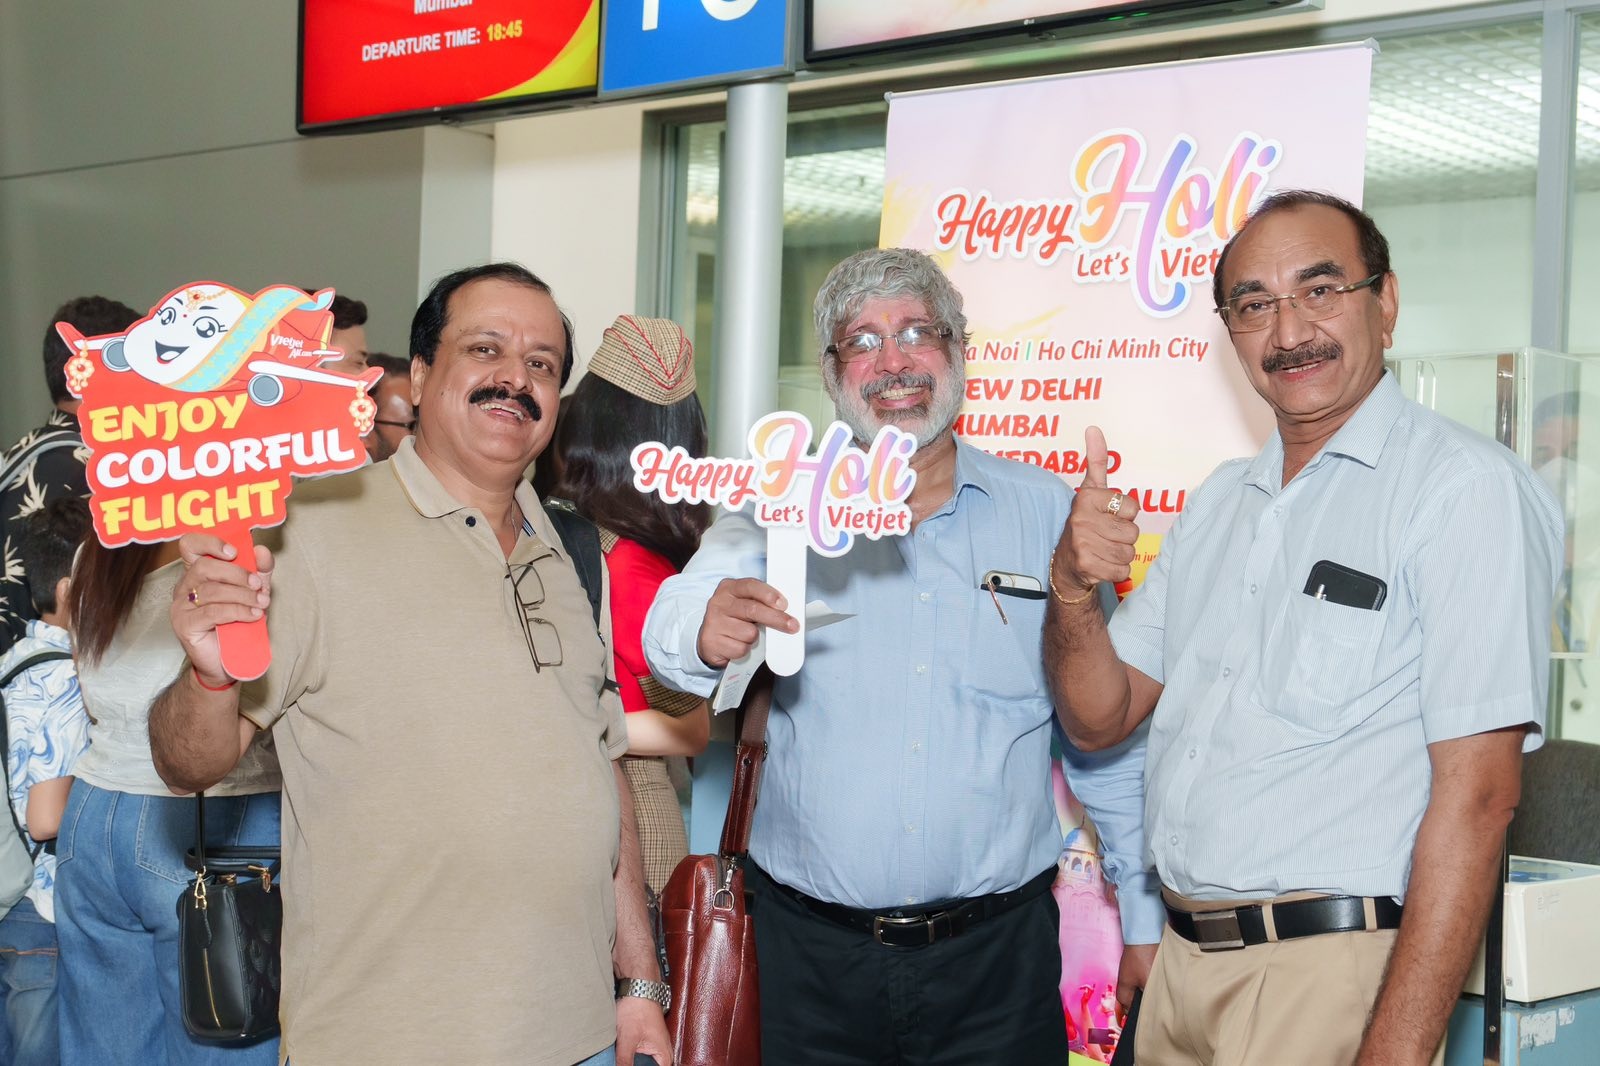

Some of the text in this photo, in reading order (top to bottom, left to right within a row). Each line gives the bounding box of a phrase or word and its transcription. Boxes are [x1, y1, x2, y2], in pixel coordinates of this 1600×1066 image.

[414, 0, 473, 15] Mum
[362, 20, 523, 62] DEPARTURE TIME: 18:45
[937, 133, 1277, 312] Happy Holi
[1077, 246, 1222, 278] Let's Viet
[983, 341, 1020, 361] Noi
[1038, 341, 1066, 361] Ho
[1071, 339, 1103, 360] Chi
[1107, 338, 1161, 359] Minh
[1167, 337, 1209, 362] City
[965, 377, 1103, 402] EW DELHI
[89, 392, 248, 443] ENJOY
[96, 427, 356, 489] COLORFUL
[637, 417, 914, 552] Happy Holi
[100, 478, 281, 536] FLIGHT
[760, 503, 908, 535] Let's Vietjet
